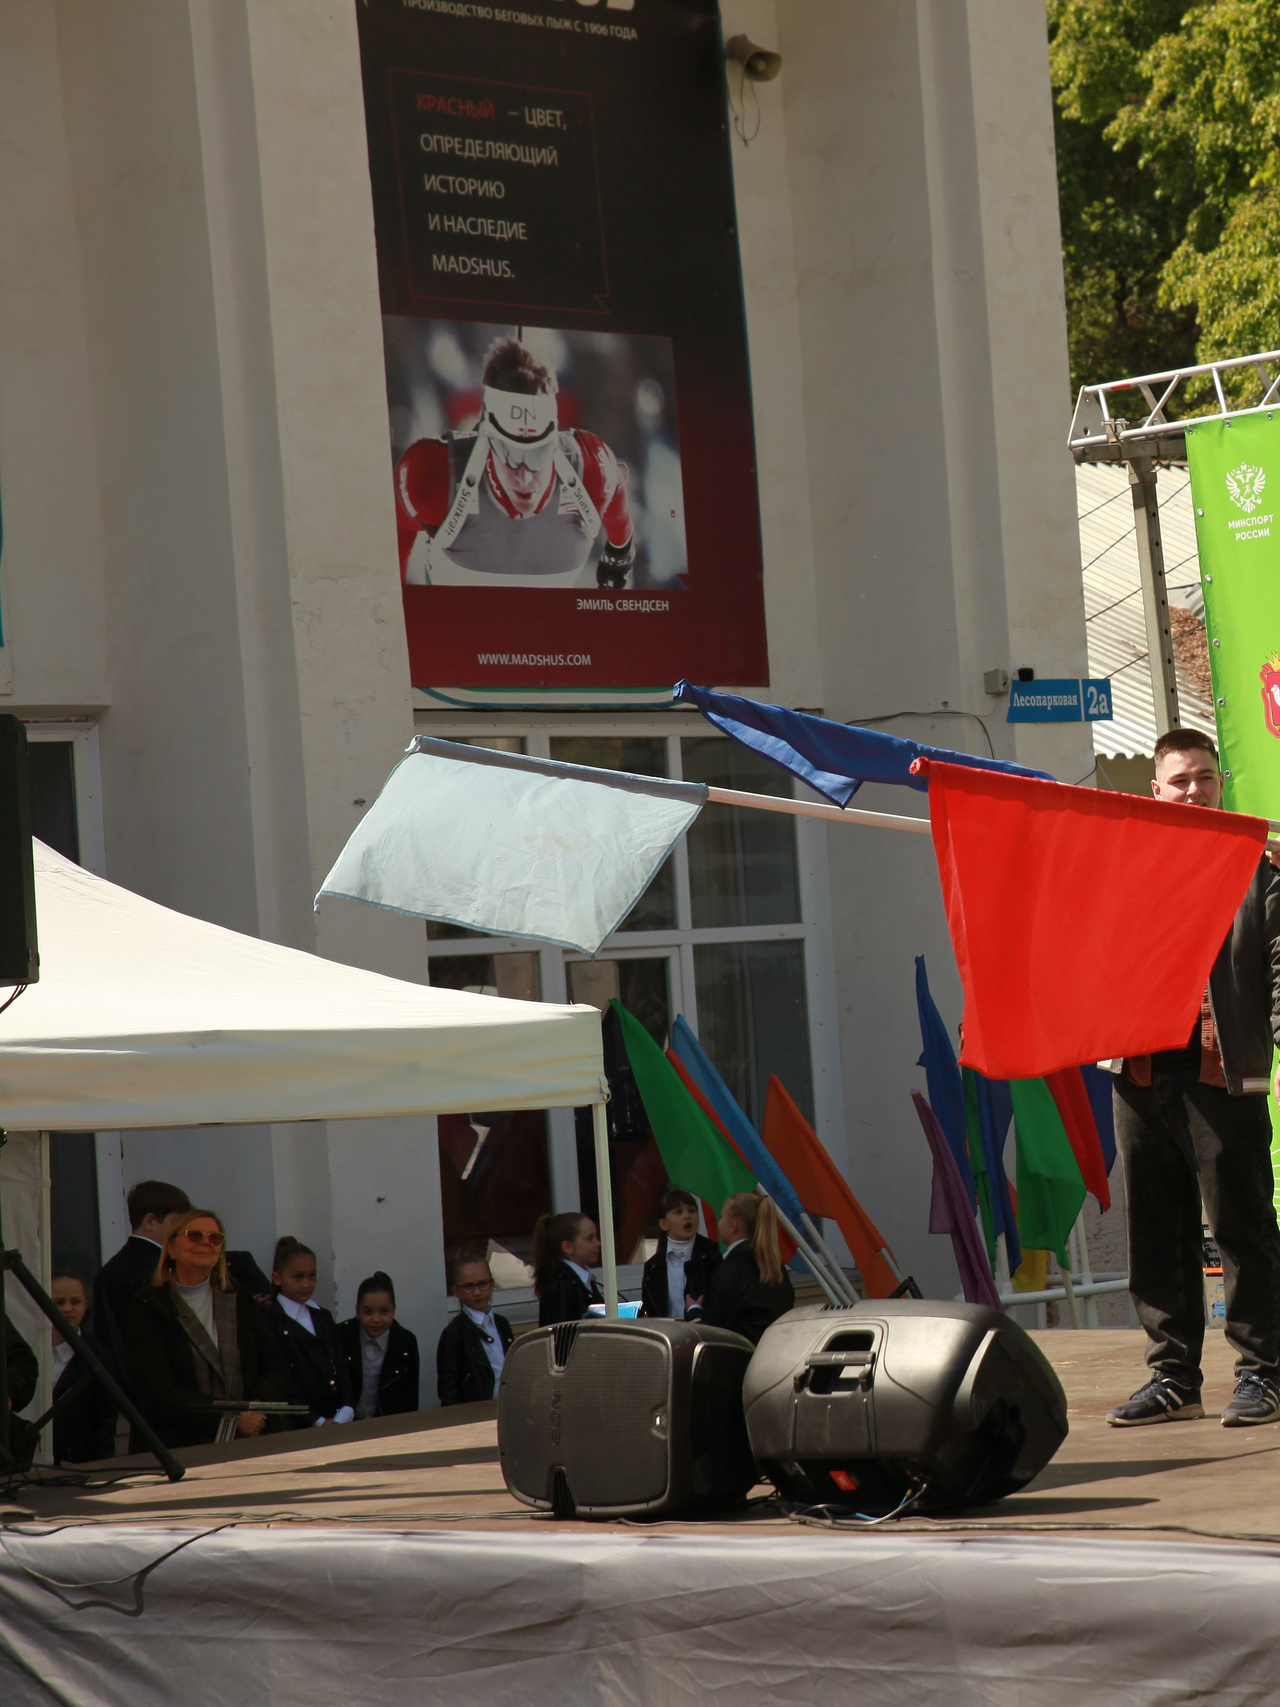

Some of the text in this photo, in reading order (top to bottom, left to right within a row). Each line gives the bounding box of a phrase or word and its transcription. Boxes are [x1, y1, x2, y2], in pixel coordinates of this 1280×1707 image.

[495, 8, 543, 27] БЕГОВЫХ
[546, 15, 572, 30] ЛЫЖ
[574, 18, 582, 31] С
[584, 22, 608, 36] 1906
[610, 25, 638, 40] ГОДА
[416, 93, 495, 119] КРАСНЫЙ
[524, 107, 567, 130] ЦВЕТ,
[420, 133, 558, 166] ОПРЕДЕЛЯЮЩИЙ
[424, 174, 505, 199] ИСТОРИЮ
[428, 213, 528, 240] И НАСЛЕДИЕ
[433, 254, 515, 279] MADSHUS.
[1228, 514, 1274, 529] МИНСПОРТ
[1235, 528, 1270, 541] РОССИИ
[576, 599, 669, 612] ЭМИЛЬ СВЕНДСЕН
[478, 653, 591, 667] WWW.MADSHUS.COM
[1013, 686, 1109, 715] Лесопарковая 2а
